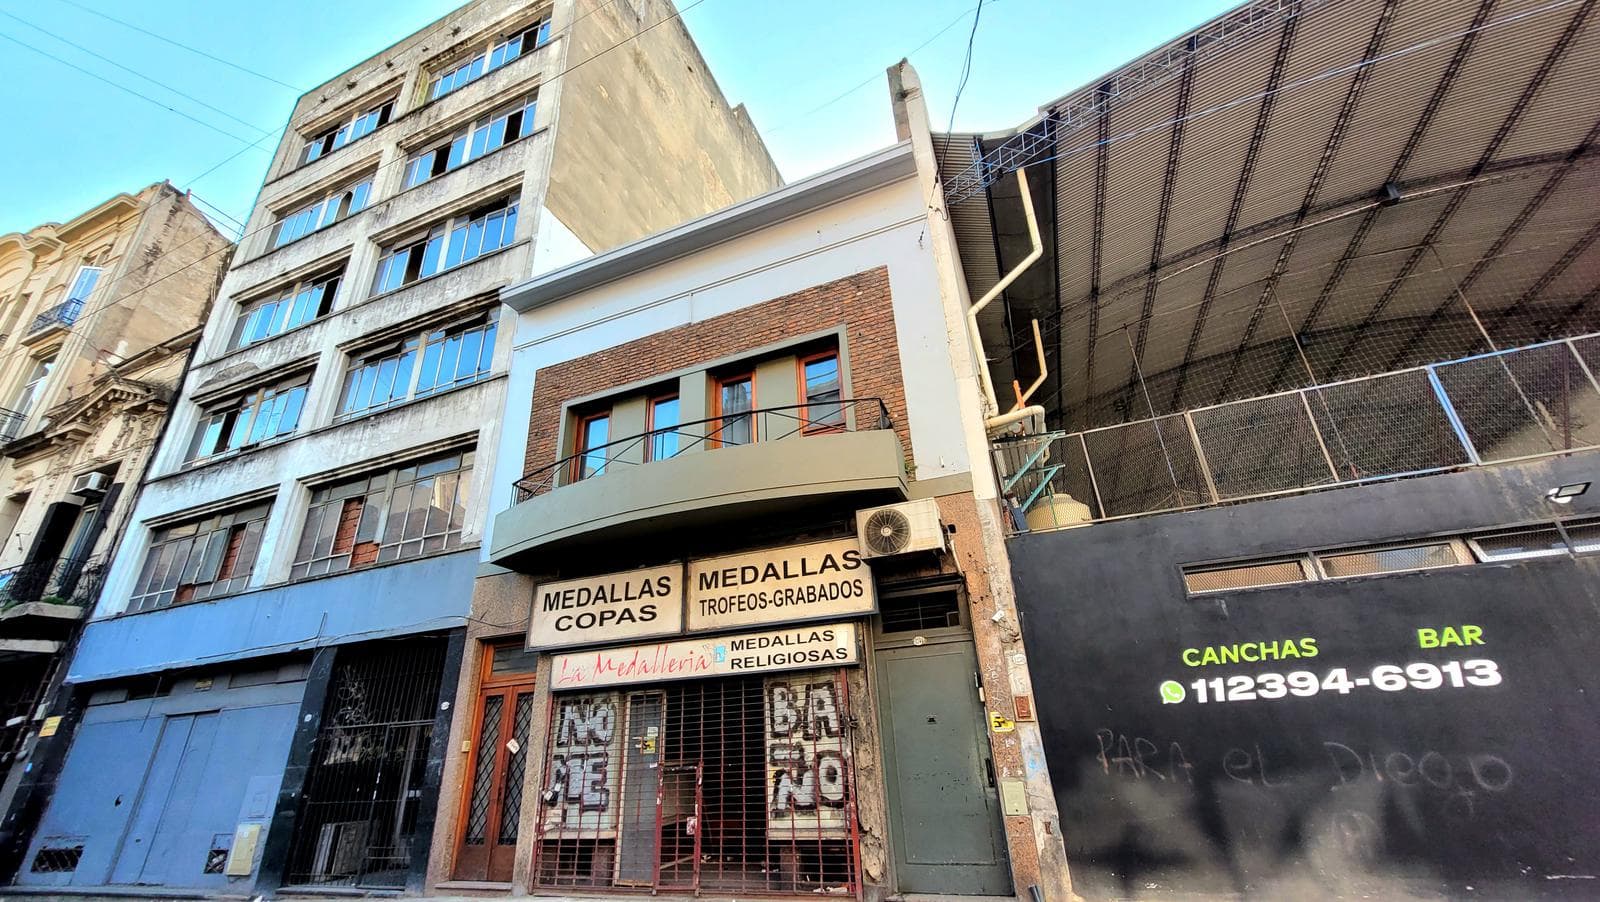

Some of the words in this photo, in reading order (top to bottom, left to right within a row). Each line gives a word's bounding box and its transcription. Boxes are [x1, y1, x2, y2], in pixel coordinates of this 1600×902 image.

[698, 550, 862, 591] MEDALLAS
[543, 576, 671, 612] MEDALLAS
[699, 579, 864, 616] TROFEOS-GRABADOS
[555, 605, 657, 632] COPAS
[1417, 625, 1486, 649] BAR
[731, 630, 834, 651] MEDALLAS
[731, 648, 848, 669] RELIGIOSAS
[1182, 637, 1319, 667] CANCHAS
[558, 658, 585, 684] La
[592, 643, 711, 682] Medalleria
[1191, 659, 1503, 703] 112394-6913
[557, 699, 617, 747] NO
[769, 682, 846, 741] BA
[1097, 728, 1194, 784] PARA
